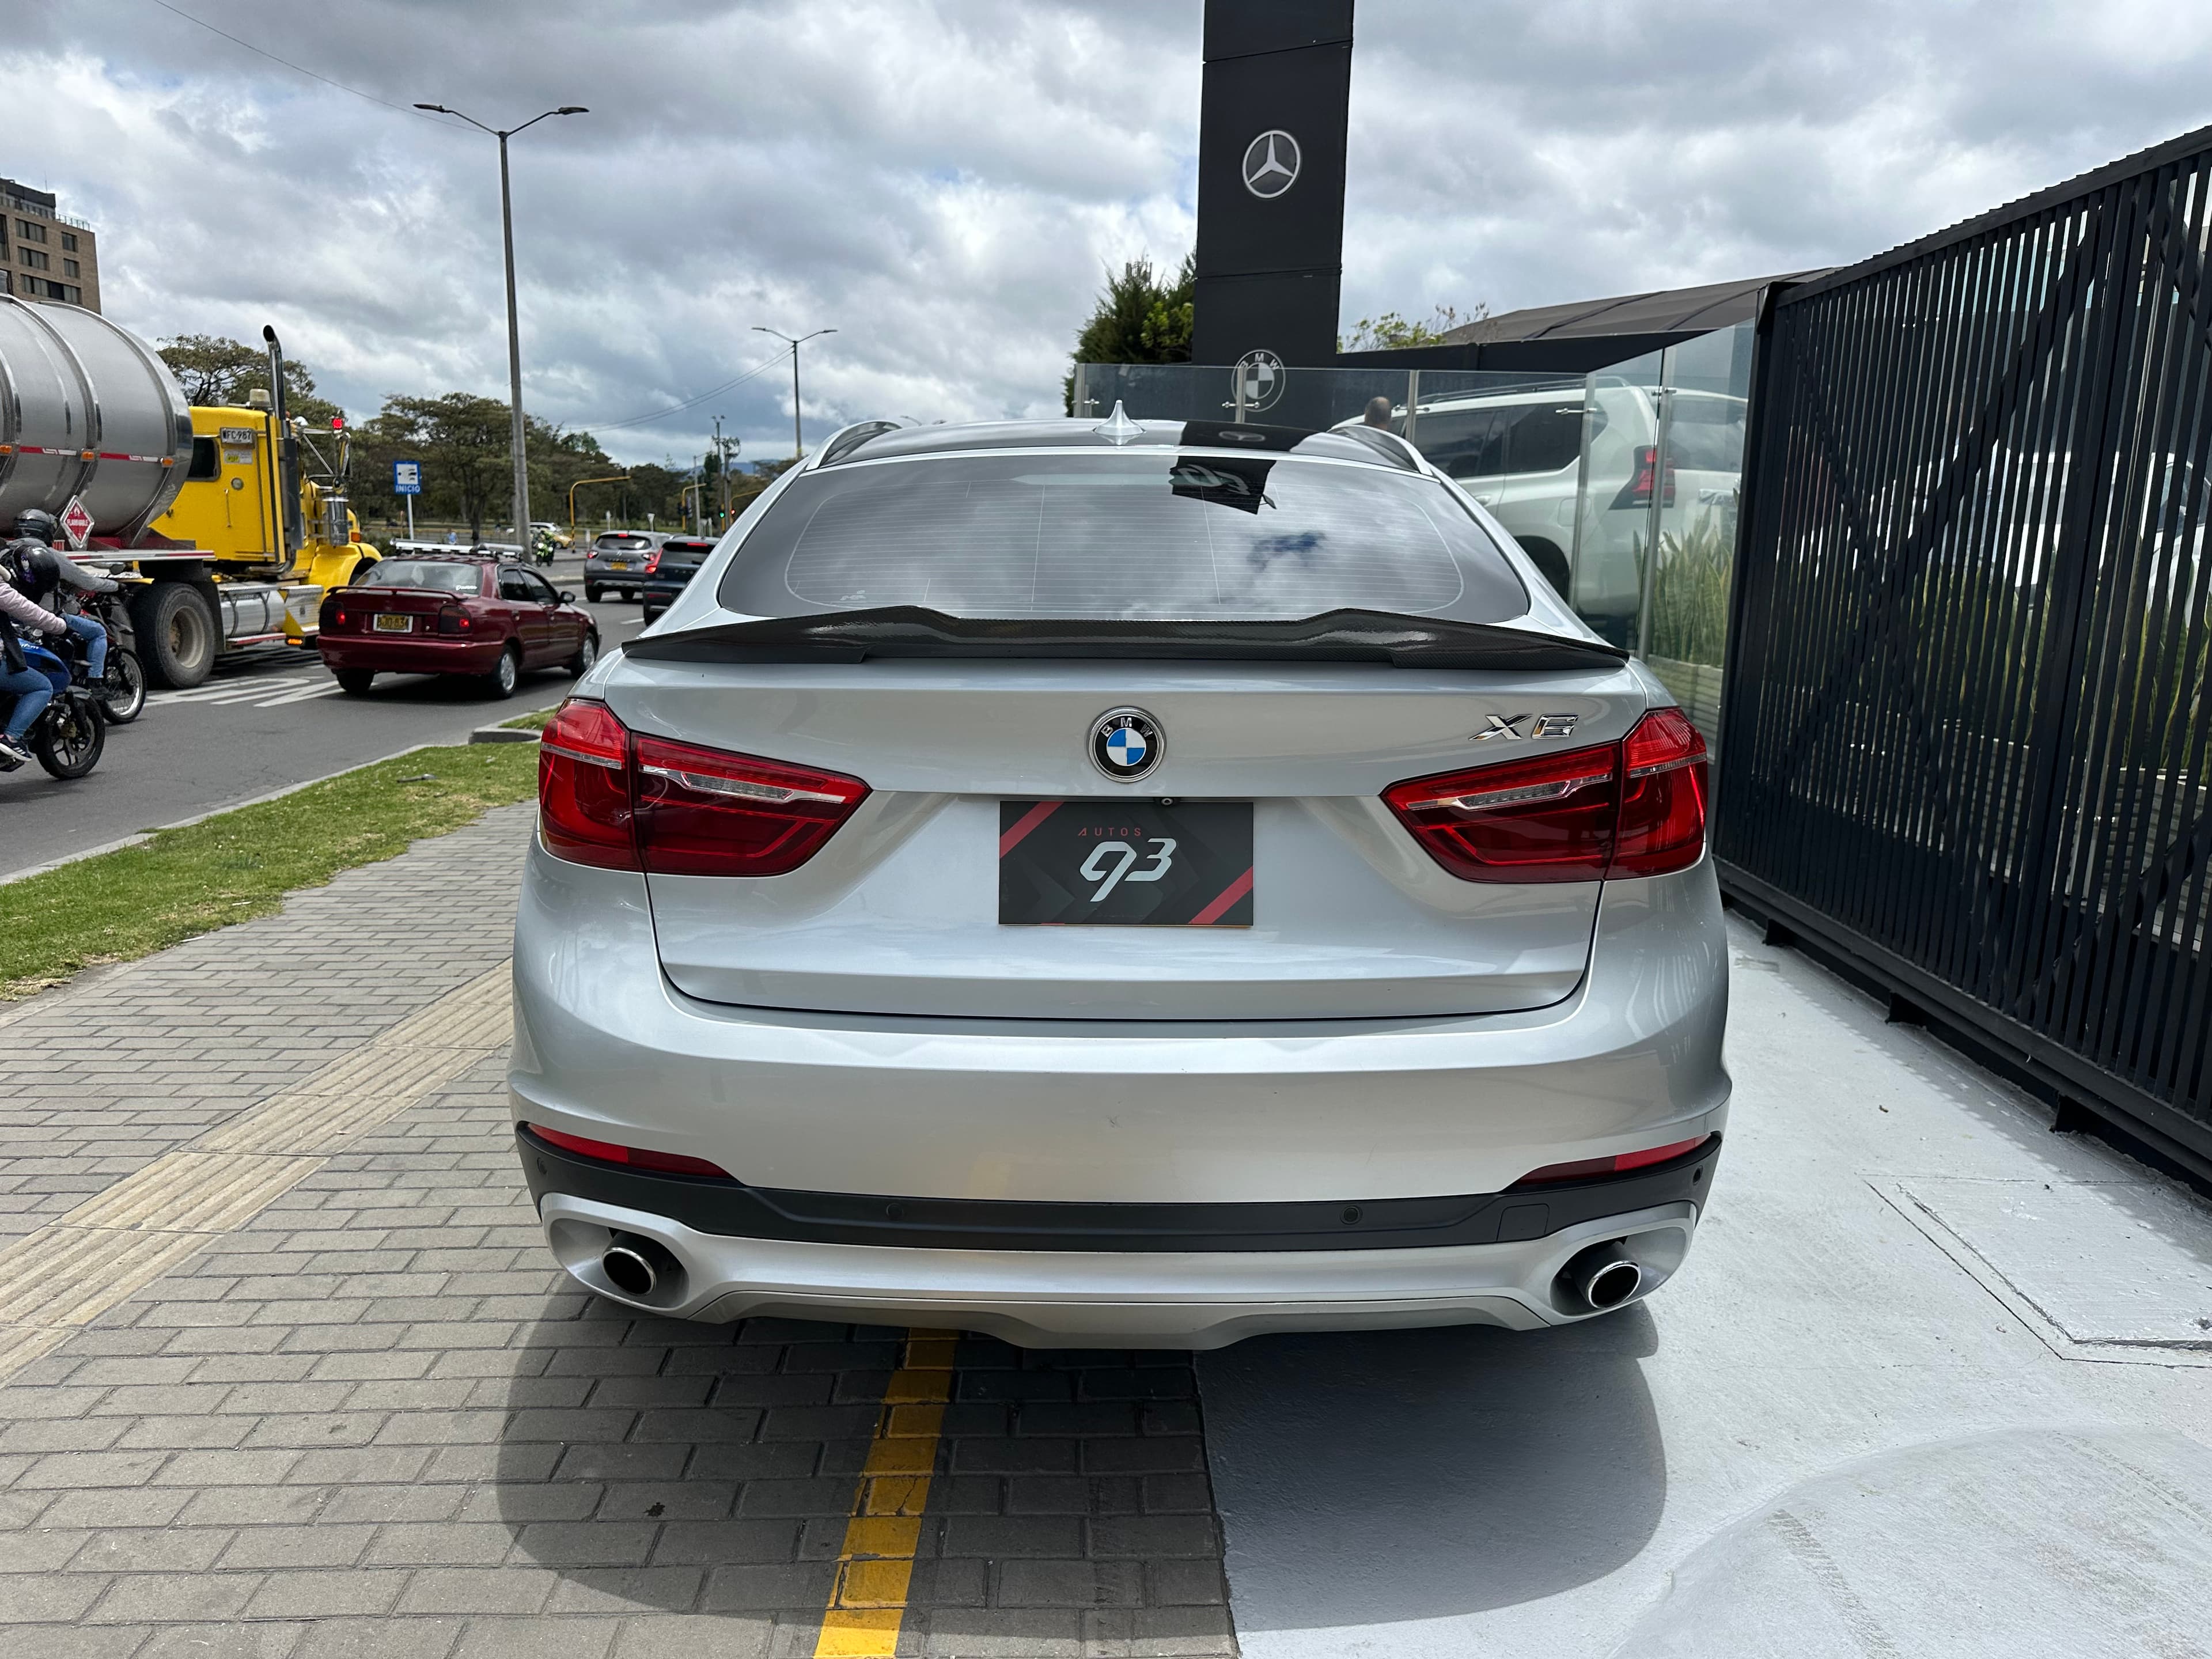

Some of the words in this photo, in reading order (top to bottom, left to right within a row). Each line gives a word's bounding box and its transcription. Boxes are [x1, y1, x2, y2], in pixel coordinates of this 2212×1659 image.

[396, 484, 421, 493] INICIO
[1100, 717, 1153, 738] BMW
[1469, 713, 1580, 740] X6
[1078, 827, 1142, 836] AUTOS
[1079, 838, 1177, 902] 93
